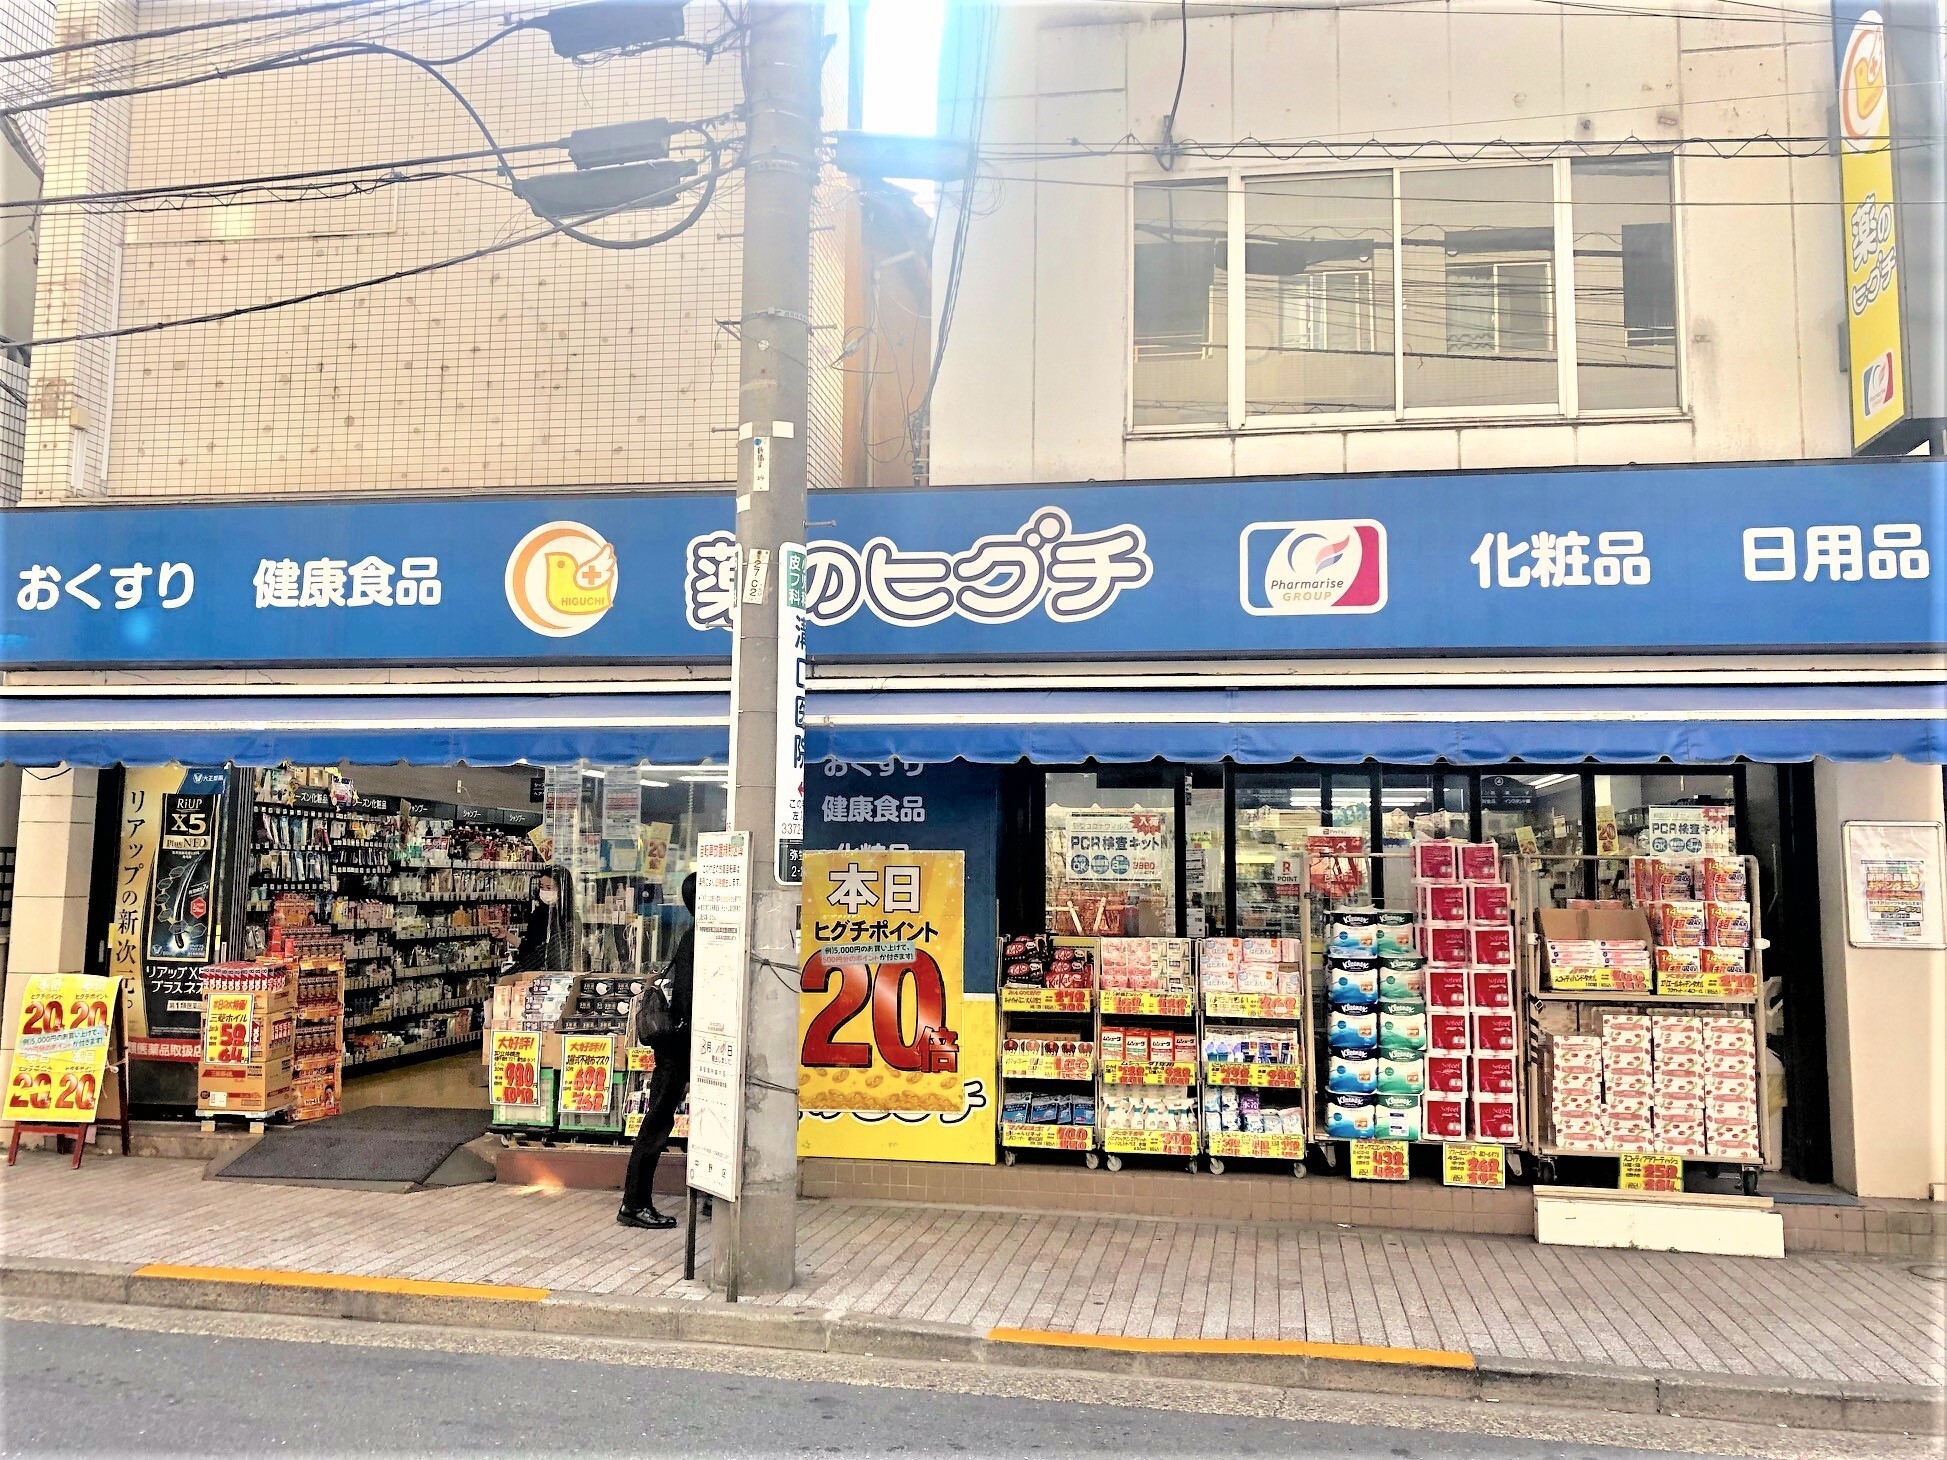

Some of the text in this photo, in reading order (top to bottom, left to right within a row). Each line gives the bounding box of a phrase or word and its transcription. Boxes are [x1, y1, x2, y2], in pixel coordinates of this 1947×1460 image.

[1851, 246, 1897, 315] ヒグチ
[1743, 523, 1931, 583] 日用品
[1471, 530, 1651, 588] 化粧品
[17, 562, 195, 611] おくすり
[252, 556, 442, 610] 健康食品
[1270, 578, 1344, 590] Pharmarise
[561, 597, 605, 606] HIGUCHI
[1282, 591, 1332, 602] GROUP
[177, 798, 203, 809] RiUP
[295, 792, 328, 805] ーズン化粧品
[411, 803, 428, 813] ャンプー
[821, 795, 926, 823] 健康食品
[171, 813, 207, 834] X5
[1277, 875, 1298, 883] POINT
[826, 863, 921, 914] 本日
[815, 919, 940, 942] ヒグチポイント
[1342, 960, 1370, 969] Kleenex
[1341, 1003, 1369, 1013] Kleenex
[1387, 1004, 1415, 1013] Kleenex
[1340, 1049, 1368, 1059] Kleenex
[1388, 1049, 1415, 1059] Kleenex
[1337, 1096, 1364, 1107] Kleenex
[1385, 1097, 1412, 1106] Kleenex
